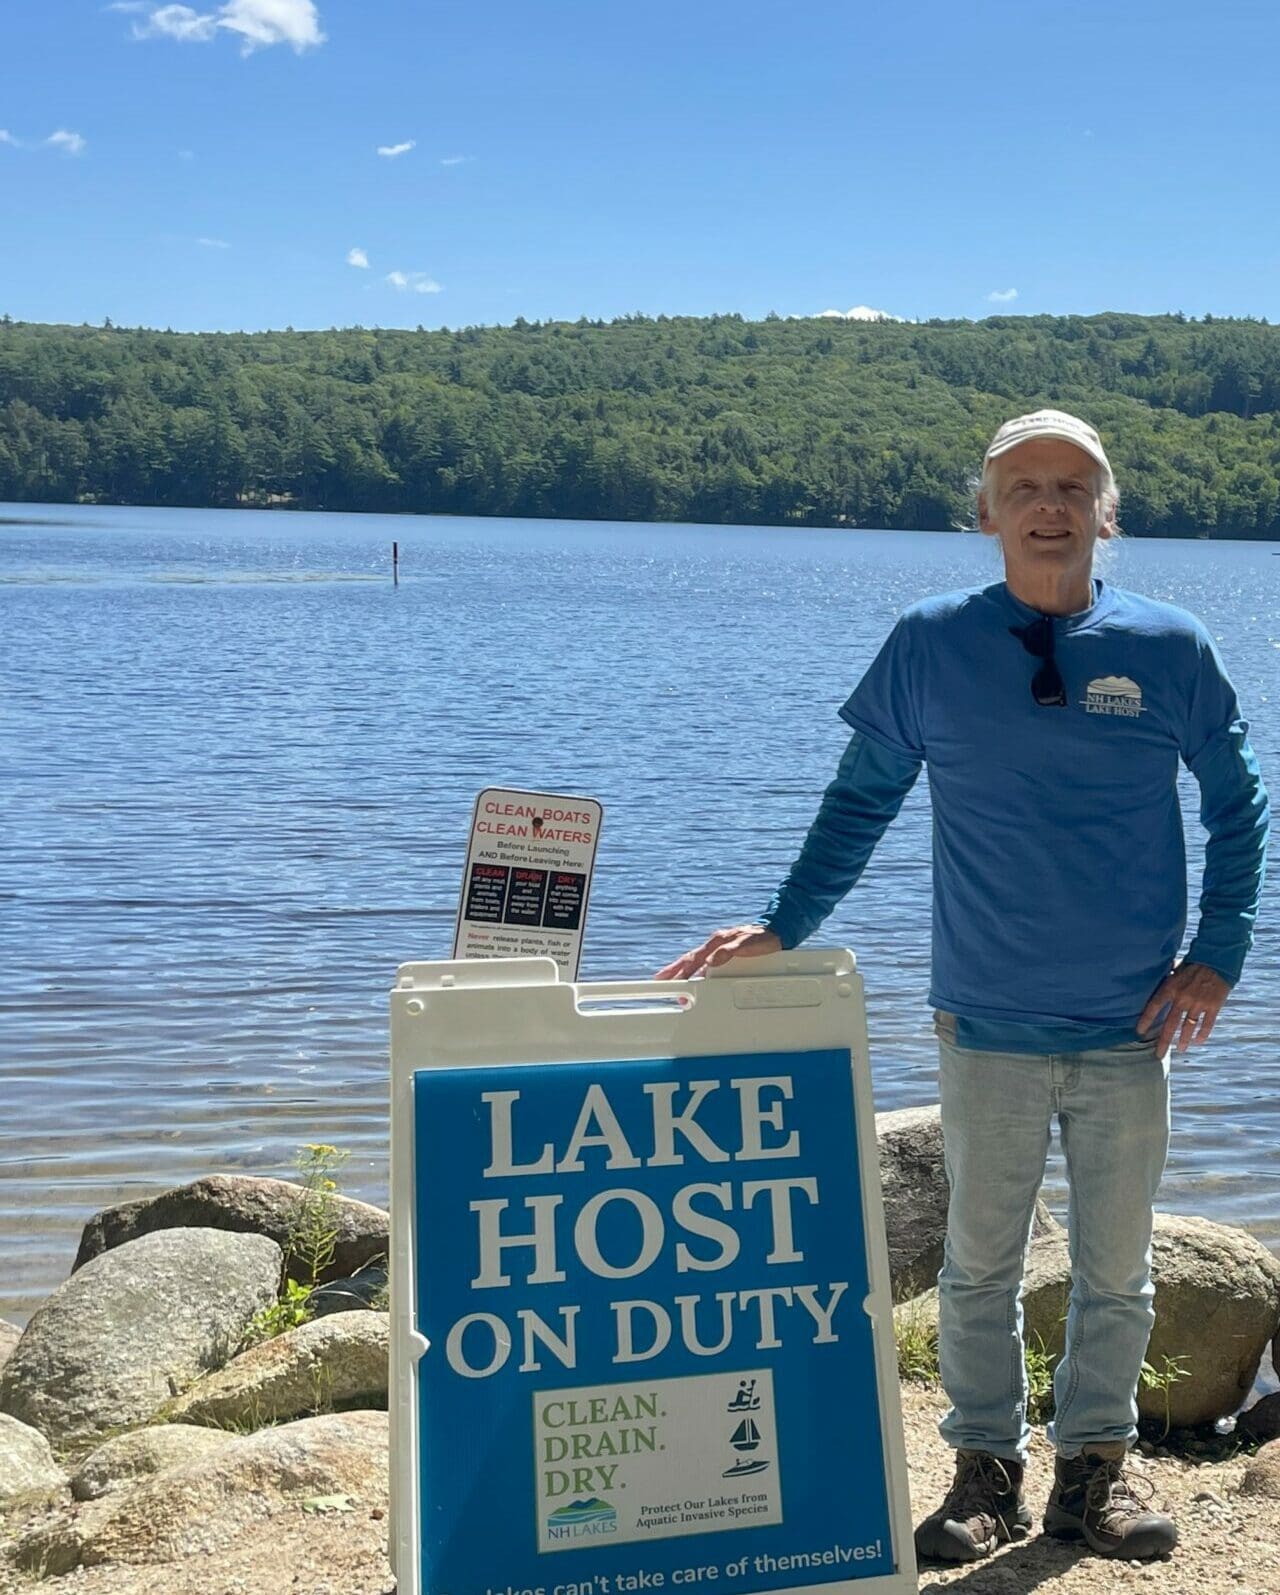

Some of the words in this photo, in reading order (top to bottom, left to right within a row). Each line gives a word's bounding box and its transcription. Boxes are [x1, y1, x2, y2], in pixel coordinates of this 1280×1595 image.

[1086, 693, 1103, 703] NH
[1107, 696, 1141, 707] LAKES
[1086, 704, 1111, 715] LAKE
[1113, 707, 1140, 718] HOST
[485, 802, 536, 818] CLEAN
[542, 808, 591, 825] BOATS
[477, 821, 527, 837] CLEAN
[532, 825, 592, 844] WATERS
[478, 850, 497, 860] AND
[499, 853, 528, 863] Before
[528, 856, 561, 868] Leaving
[497, 841, 525, 852] Before
[527, 845, 570, 857] Launching
[467, 932, 490, 940] Never
[493, 935, 519, 943] release
[466, 943, 494, 951] animals
[520, 947, 538, 955] body
[480, 1075, 801, 1178] LAKE
[468, 1176, 819, 1289] HOST
[445, 1305, 581, 1378] ON
[609, 1281, 849, 1364] DUTY
[542, 1393, 667, 1429] CLEAN.
[543, 1426, 666, 1463] DRAIN.
[544, 1464, 627, 1498] DRY.
[640, 1503, 682, 1516] Protect
[684, 1500, 706, 1510] Our
[708, 1495, 740, 1509] Lakes
[741, 1492, 769, 1504] from
[636, 1512, 678, 1529] Aquatic
[680, 1509, 726, 1522] Invasive
[728, 1503, 769, 1519] Species
[547, 1526, 570, 1540] NH
[573, 1521, 618, 1537] LAKES
[553, 1575, 610, 1595] can't
[615, 1569, 665, 1592] take
[671, 1566, 719, 1584] care
[725, 1556, 749, 1577] of
[753, 1539, 882, 1573] themselves!
